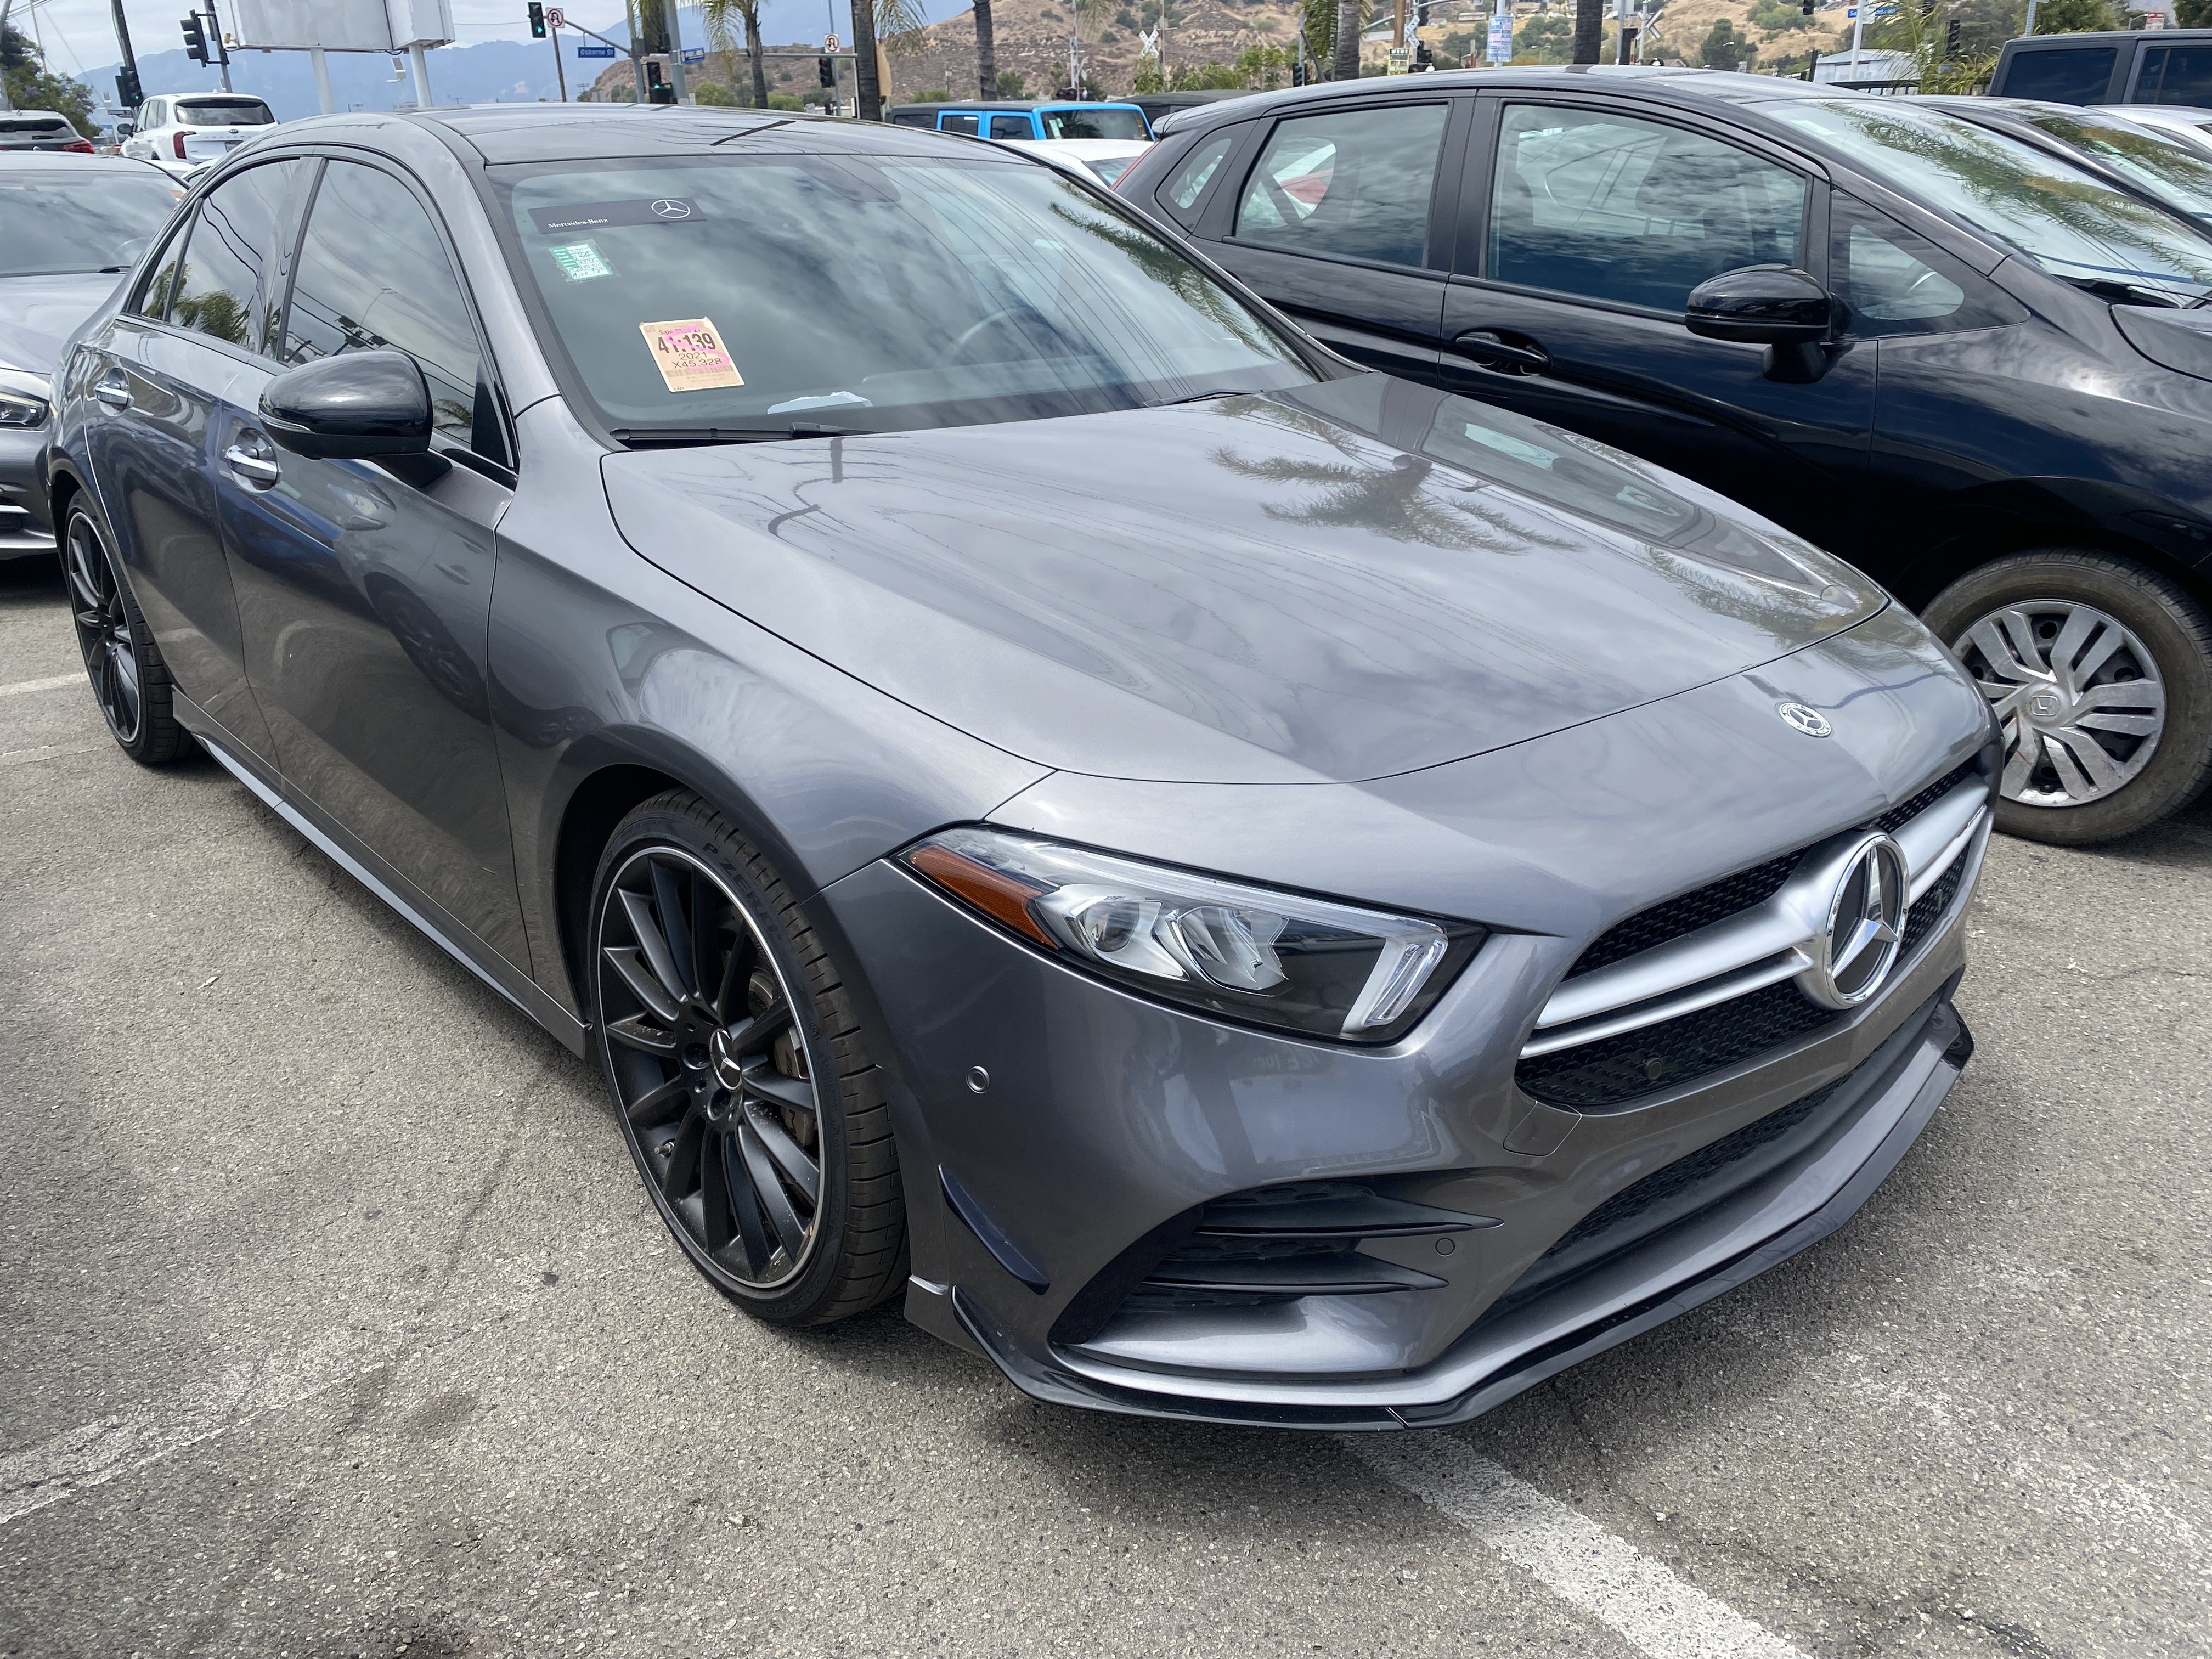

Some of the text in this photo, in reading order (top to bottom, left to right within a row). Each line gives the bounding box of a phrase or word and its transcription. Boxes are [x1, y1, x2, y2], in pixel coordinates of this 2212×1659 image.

[548, 218, 608, 228] Mercedes-Benz
[658, 332, 716, 353] 41:139
[679, 352, 708, 360] 2021
